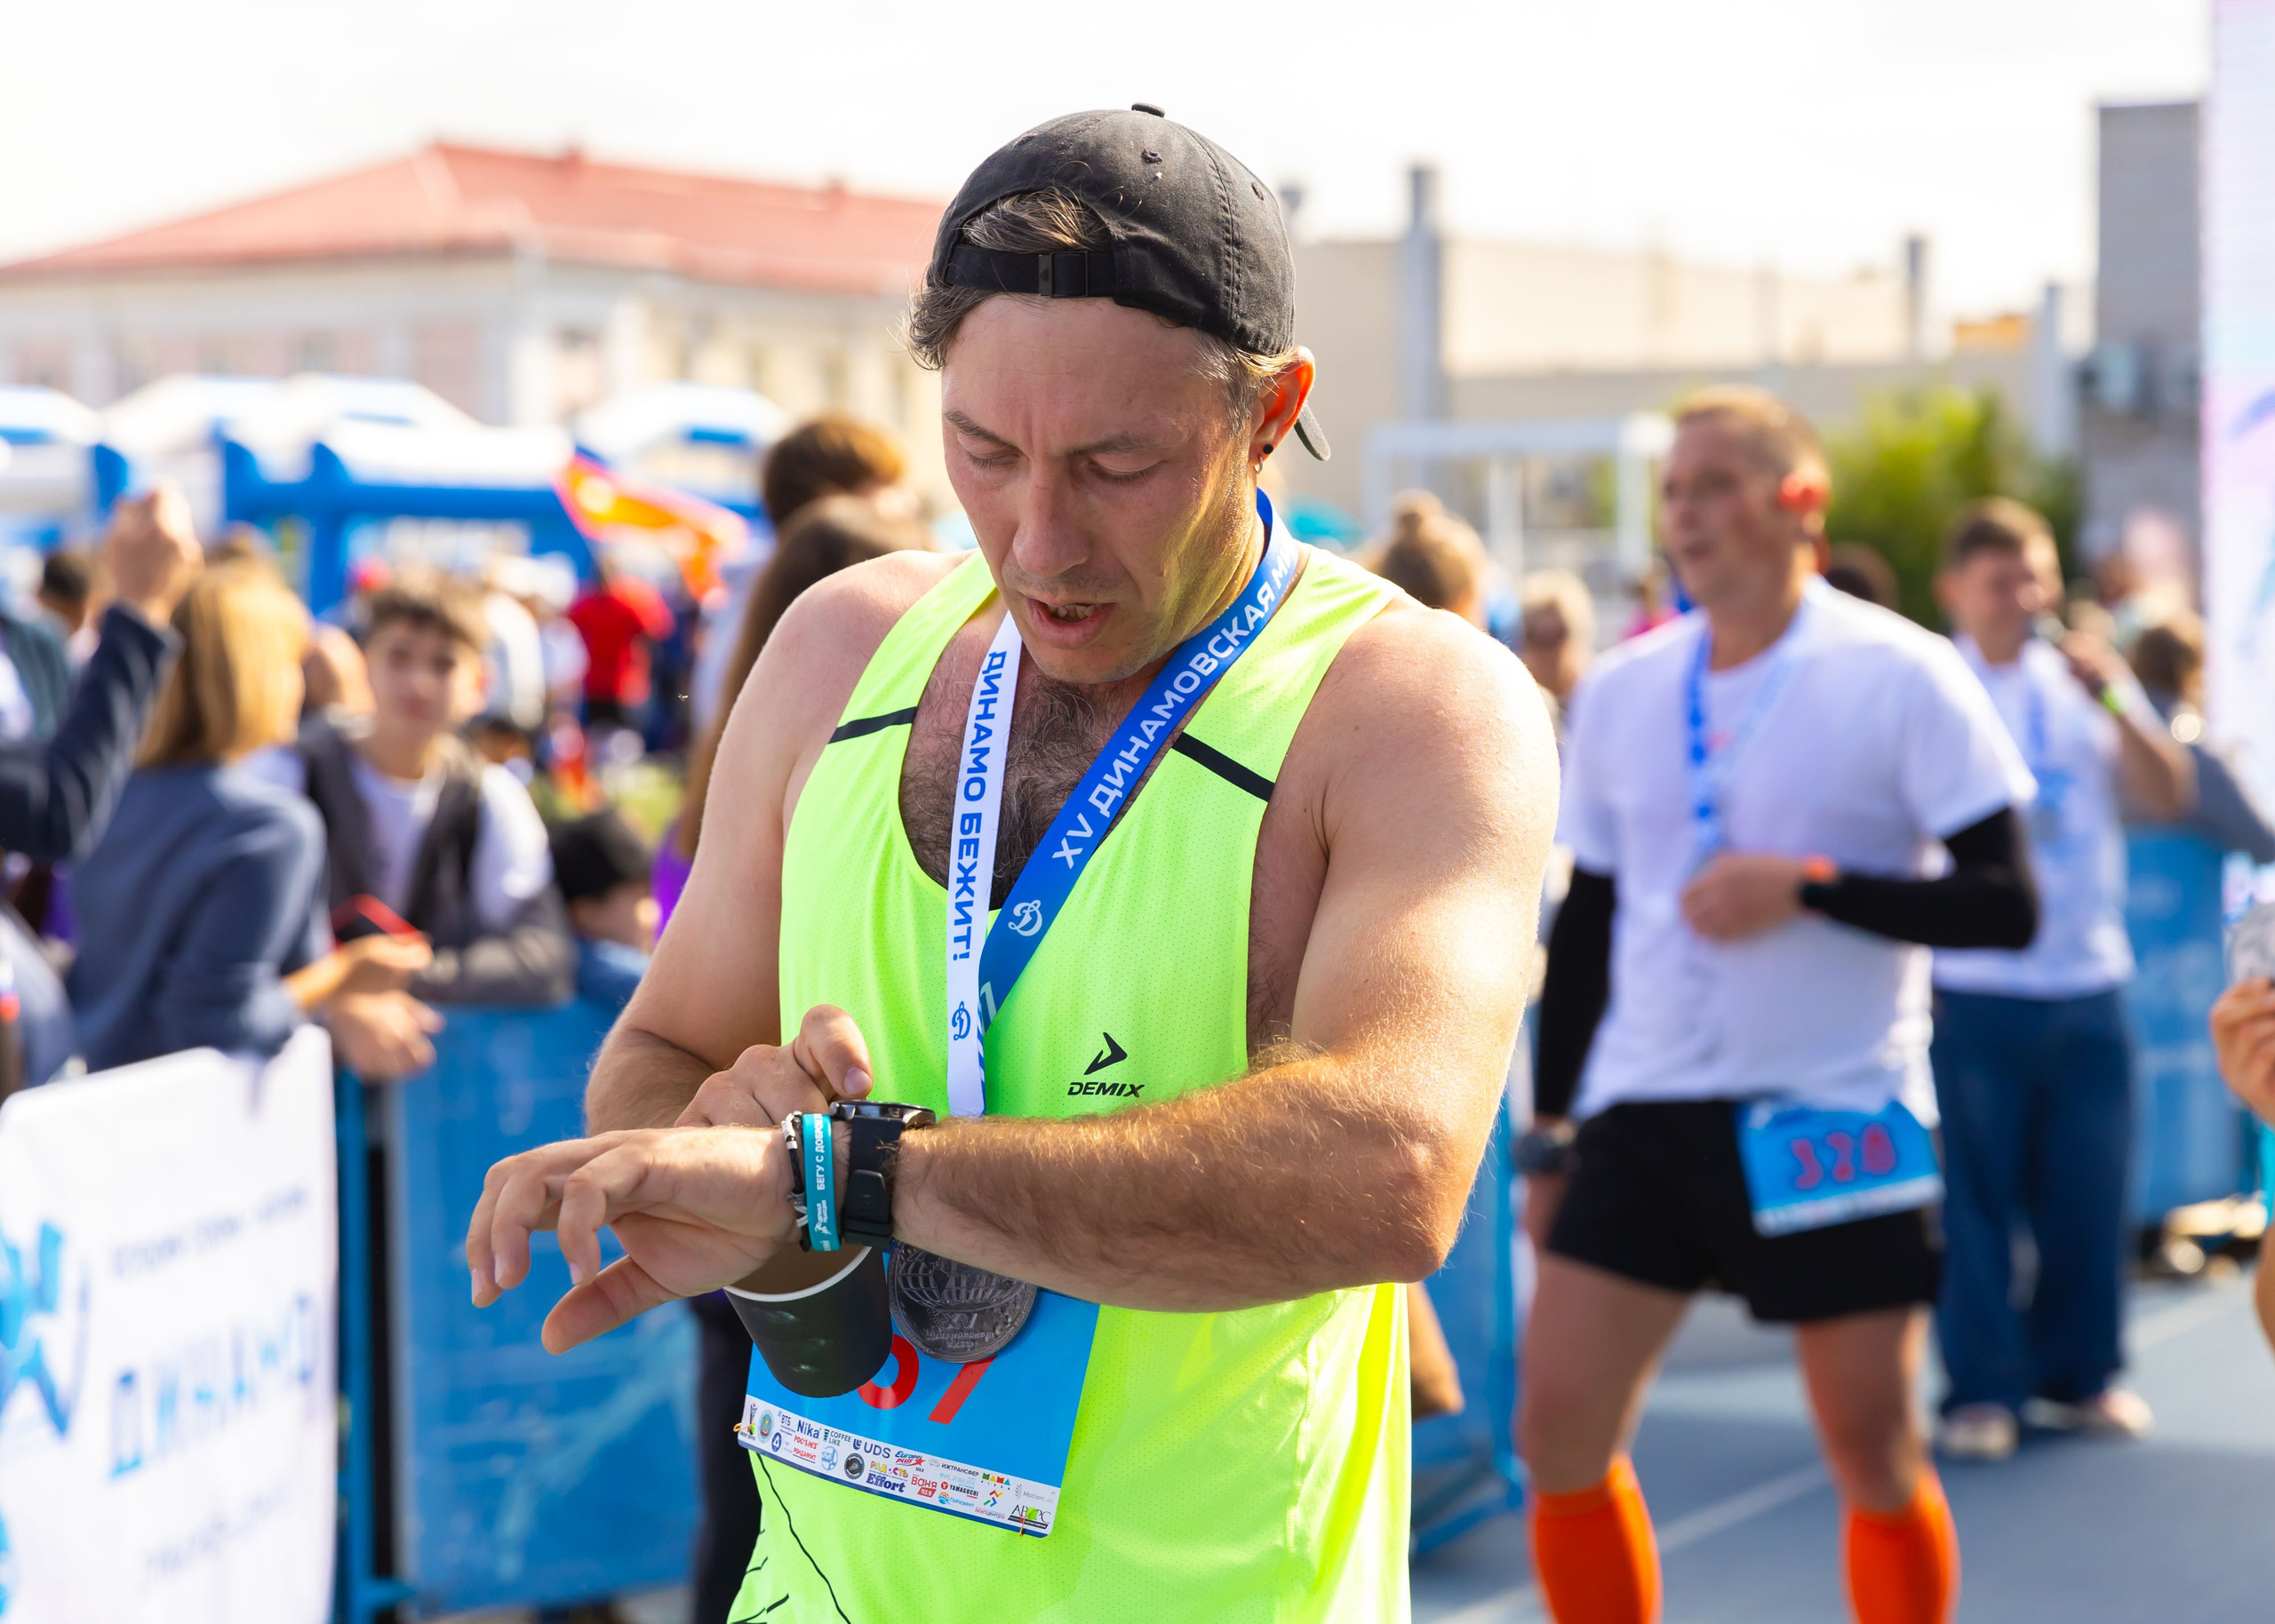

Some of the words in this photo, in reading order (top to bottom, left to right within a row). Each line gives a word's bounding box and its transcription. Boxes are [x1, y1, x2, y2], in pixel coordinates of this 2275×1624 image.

[954, 650, 1007, 802] ДИНАМО
[1052, 812, 1095, 870] XV
[1087, 580, 1276, 820] ДИНАМОВСКАЯ
[953, 818, 982, 960] БЕЖИТ!
[1067, 1082, 1145, 1098] DEMIX
[816, 1166, 826, 1190] БЕГУ
[780, 1414, 791, 1426] ВТБ
[796, 1420, 820, 1439] Nika
[830, 1430, 851, 1443] COFFEE
[828, 1437, 842, 1446] LIKE
[864, 1442, 891, 1459] UDS
[941, 1463, 979, 1477] ИЖТРАНСФЕР
[866, 1473, 906, 1493] Effort
[950, 1485, 979, 1497] YAMAGUCHI
